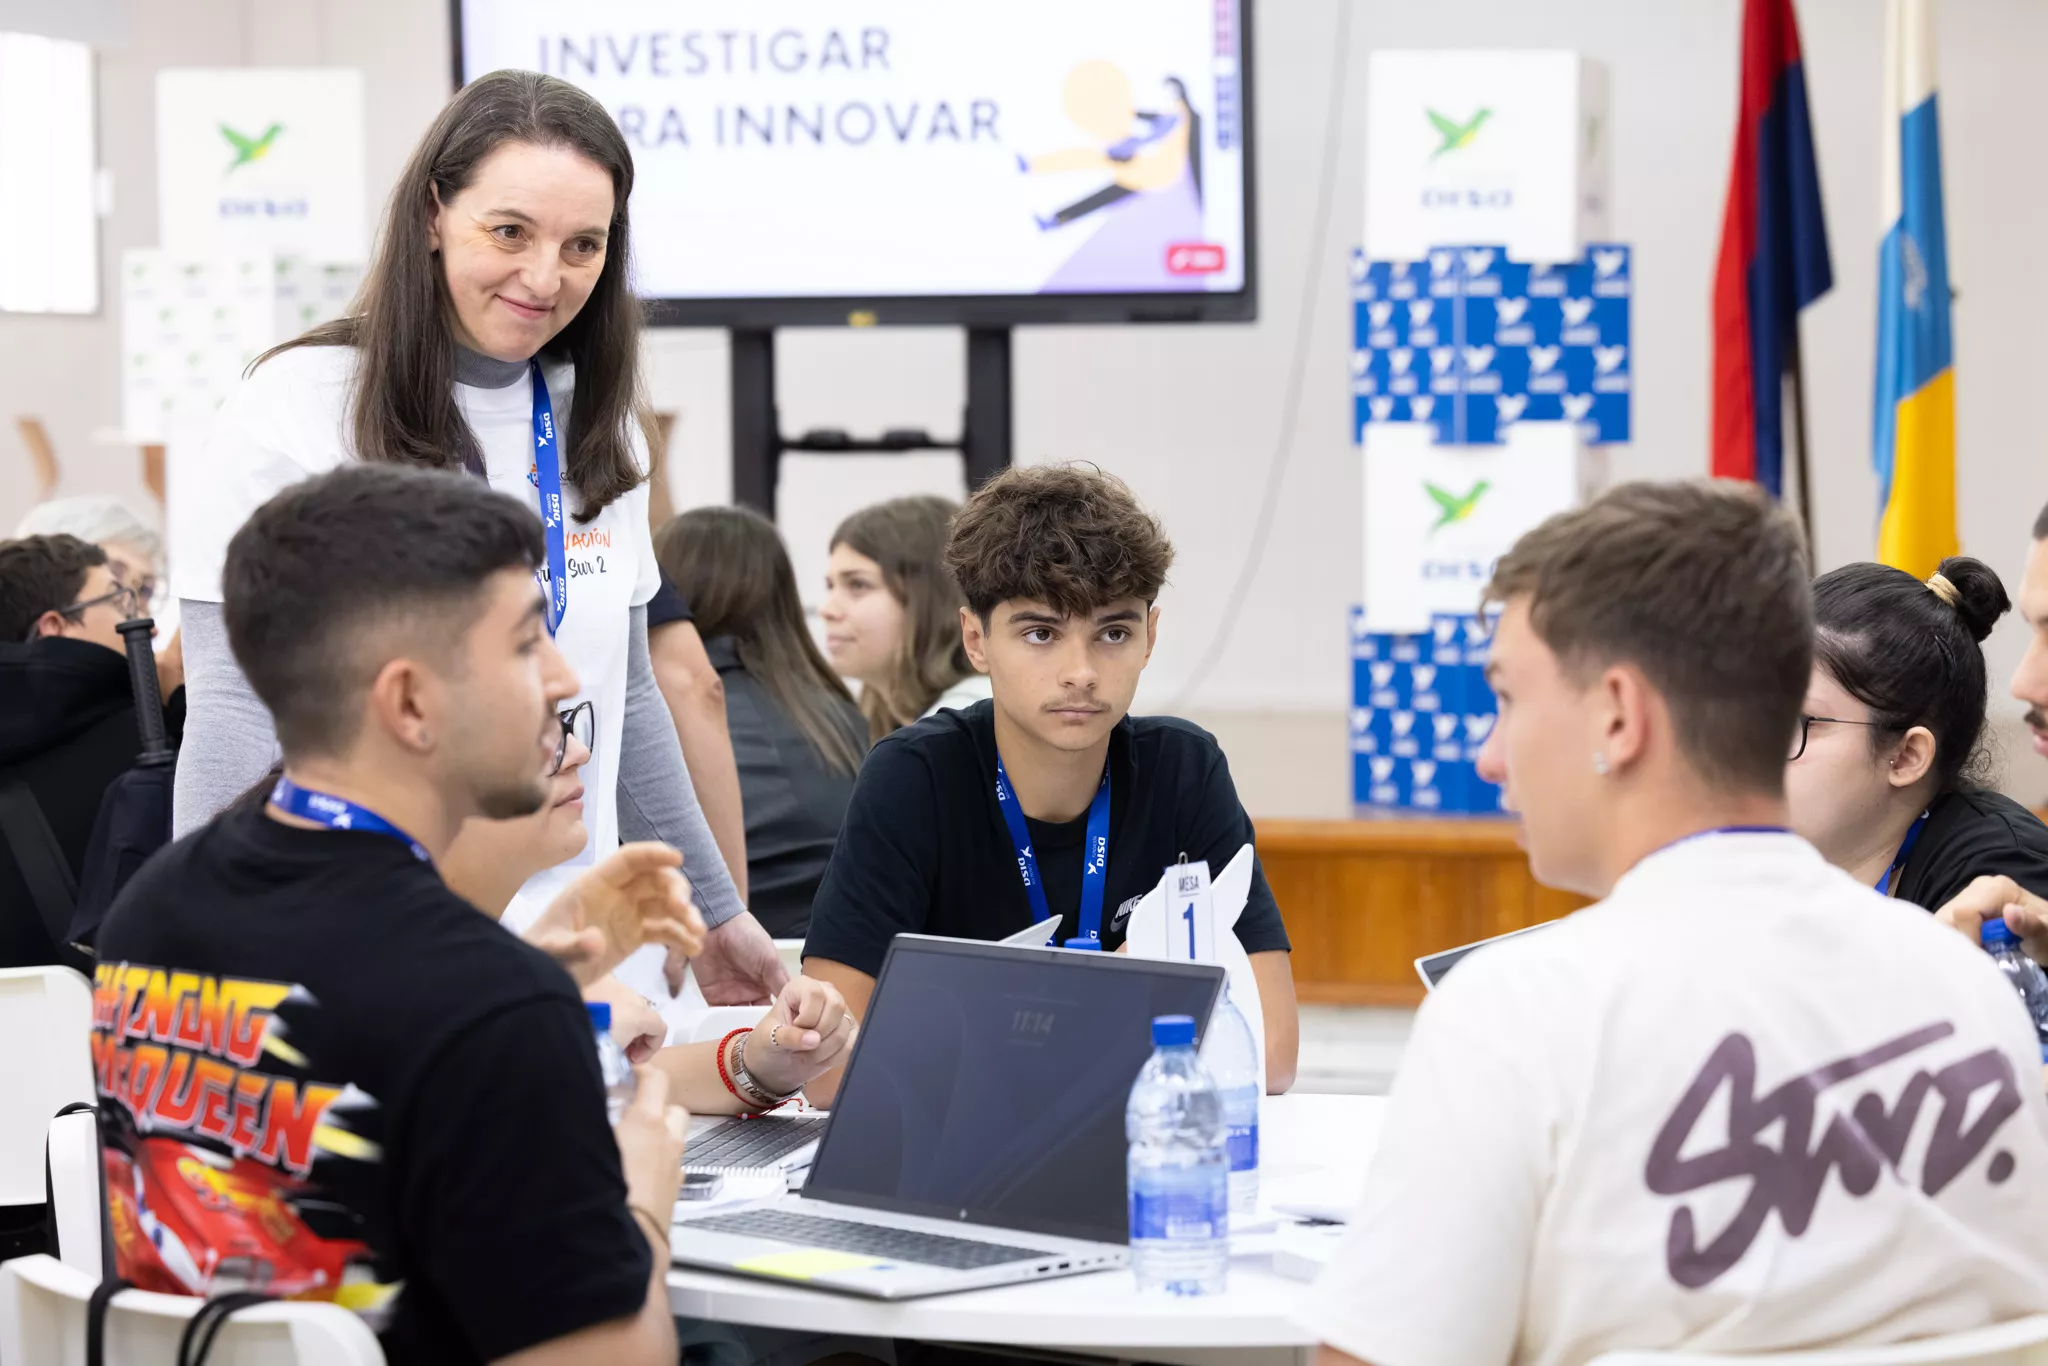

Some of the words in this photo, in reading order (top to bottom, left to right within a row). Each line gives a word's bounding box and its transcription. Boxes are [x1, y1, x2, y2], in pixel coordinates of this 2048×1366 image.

[539, 29, 890, 77] INVESTIGAR
[618, 104, 690, 149] RA
[716, 99, 1000, 146] INNOVAR
[564, 527, 611, 551] VACIÓN
[567, 557, 594, 578] Sur
[596, 555, 607, 573] 2
[1178, 875, 1200, 892] MESA
[1182, 902, 1196, 960] 1
